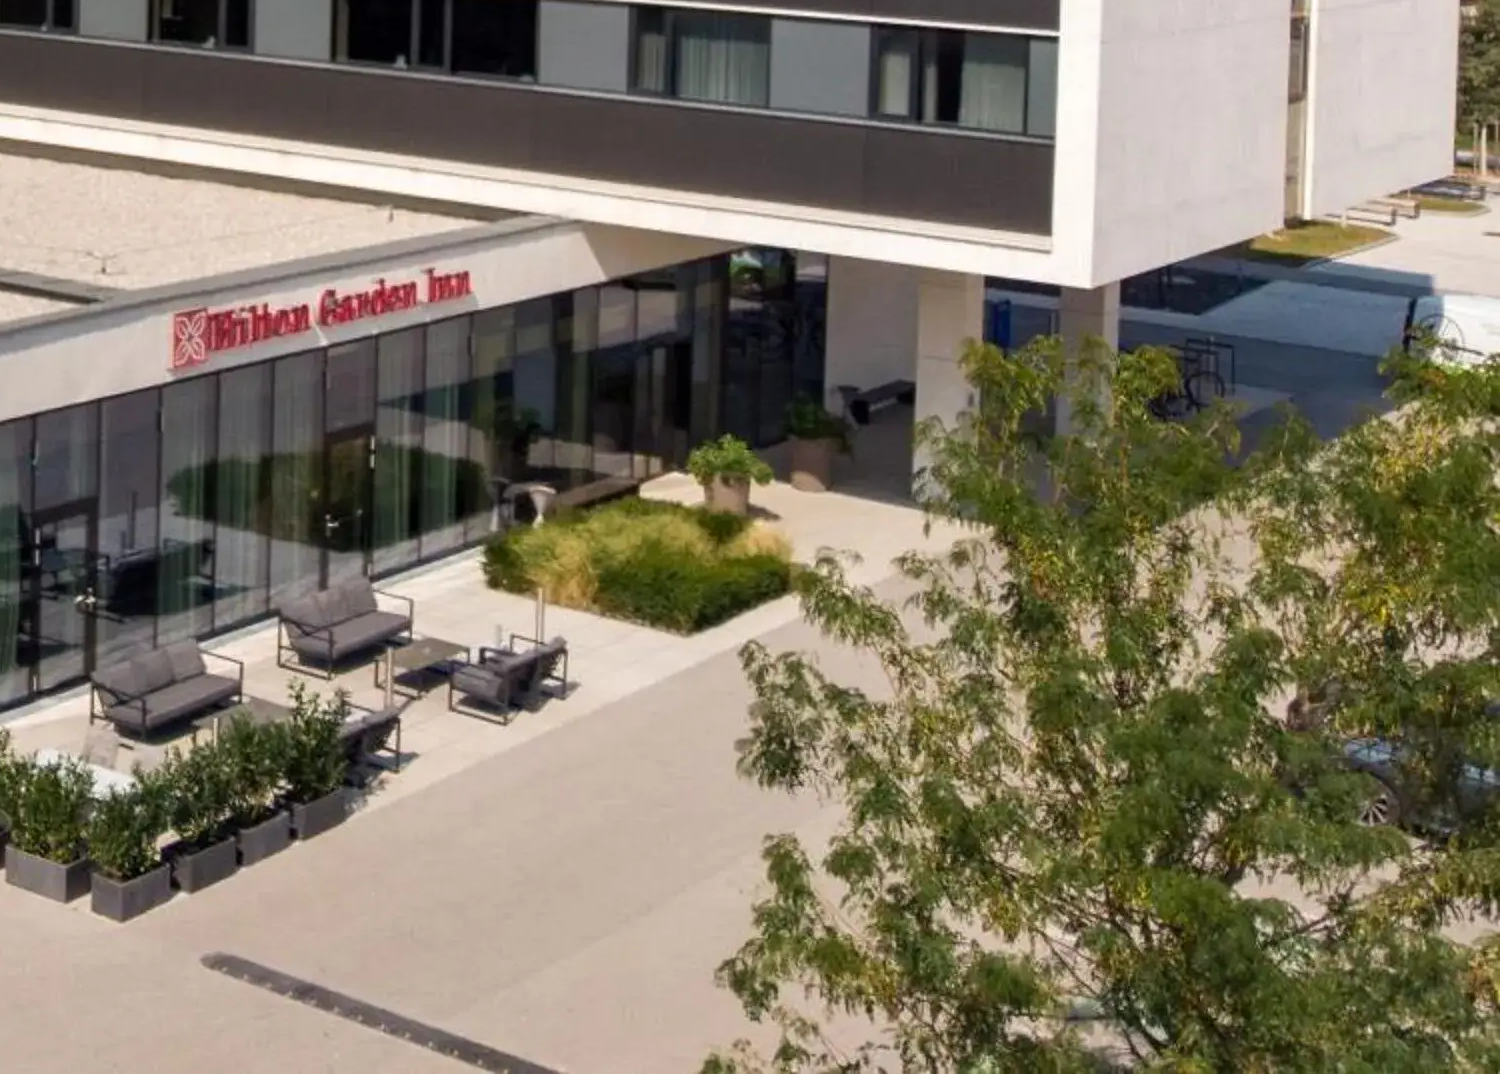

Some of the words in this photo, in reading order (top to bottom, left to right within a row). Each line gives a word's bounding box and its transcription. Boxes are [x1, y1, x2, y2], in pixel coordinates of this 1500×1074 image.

[206, 302, 312, 352] Hilton
[319, 278, 418, 327] Garden
[421, 268, 471, 304] Inn
